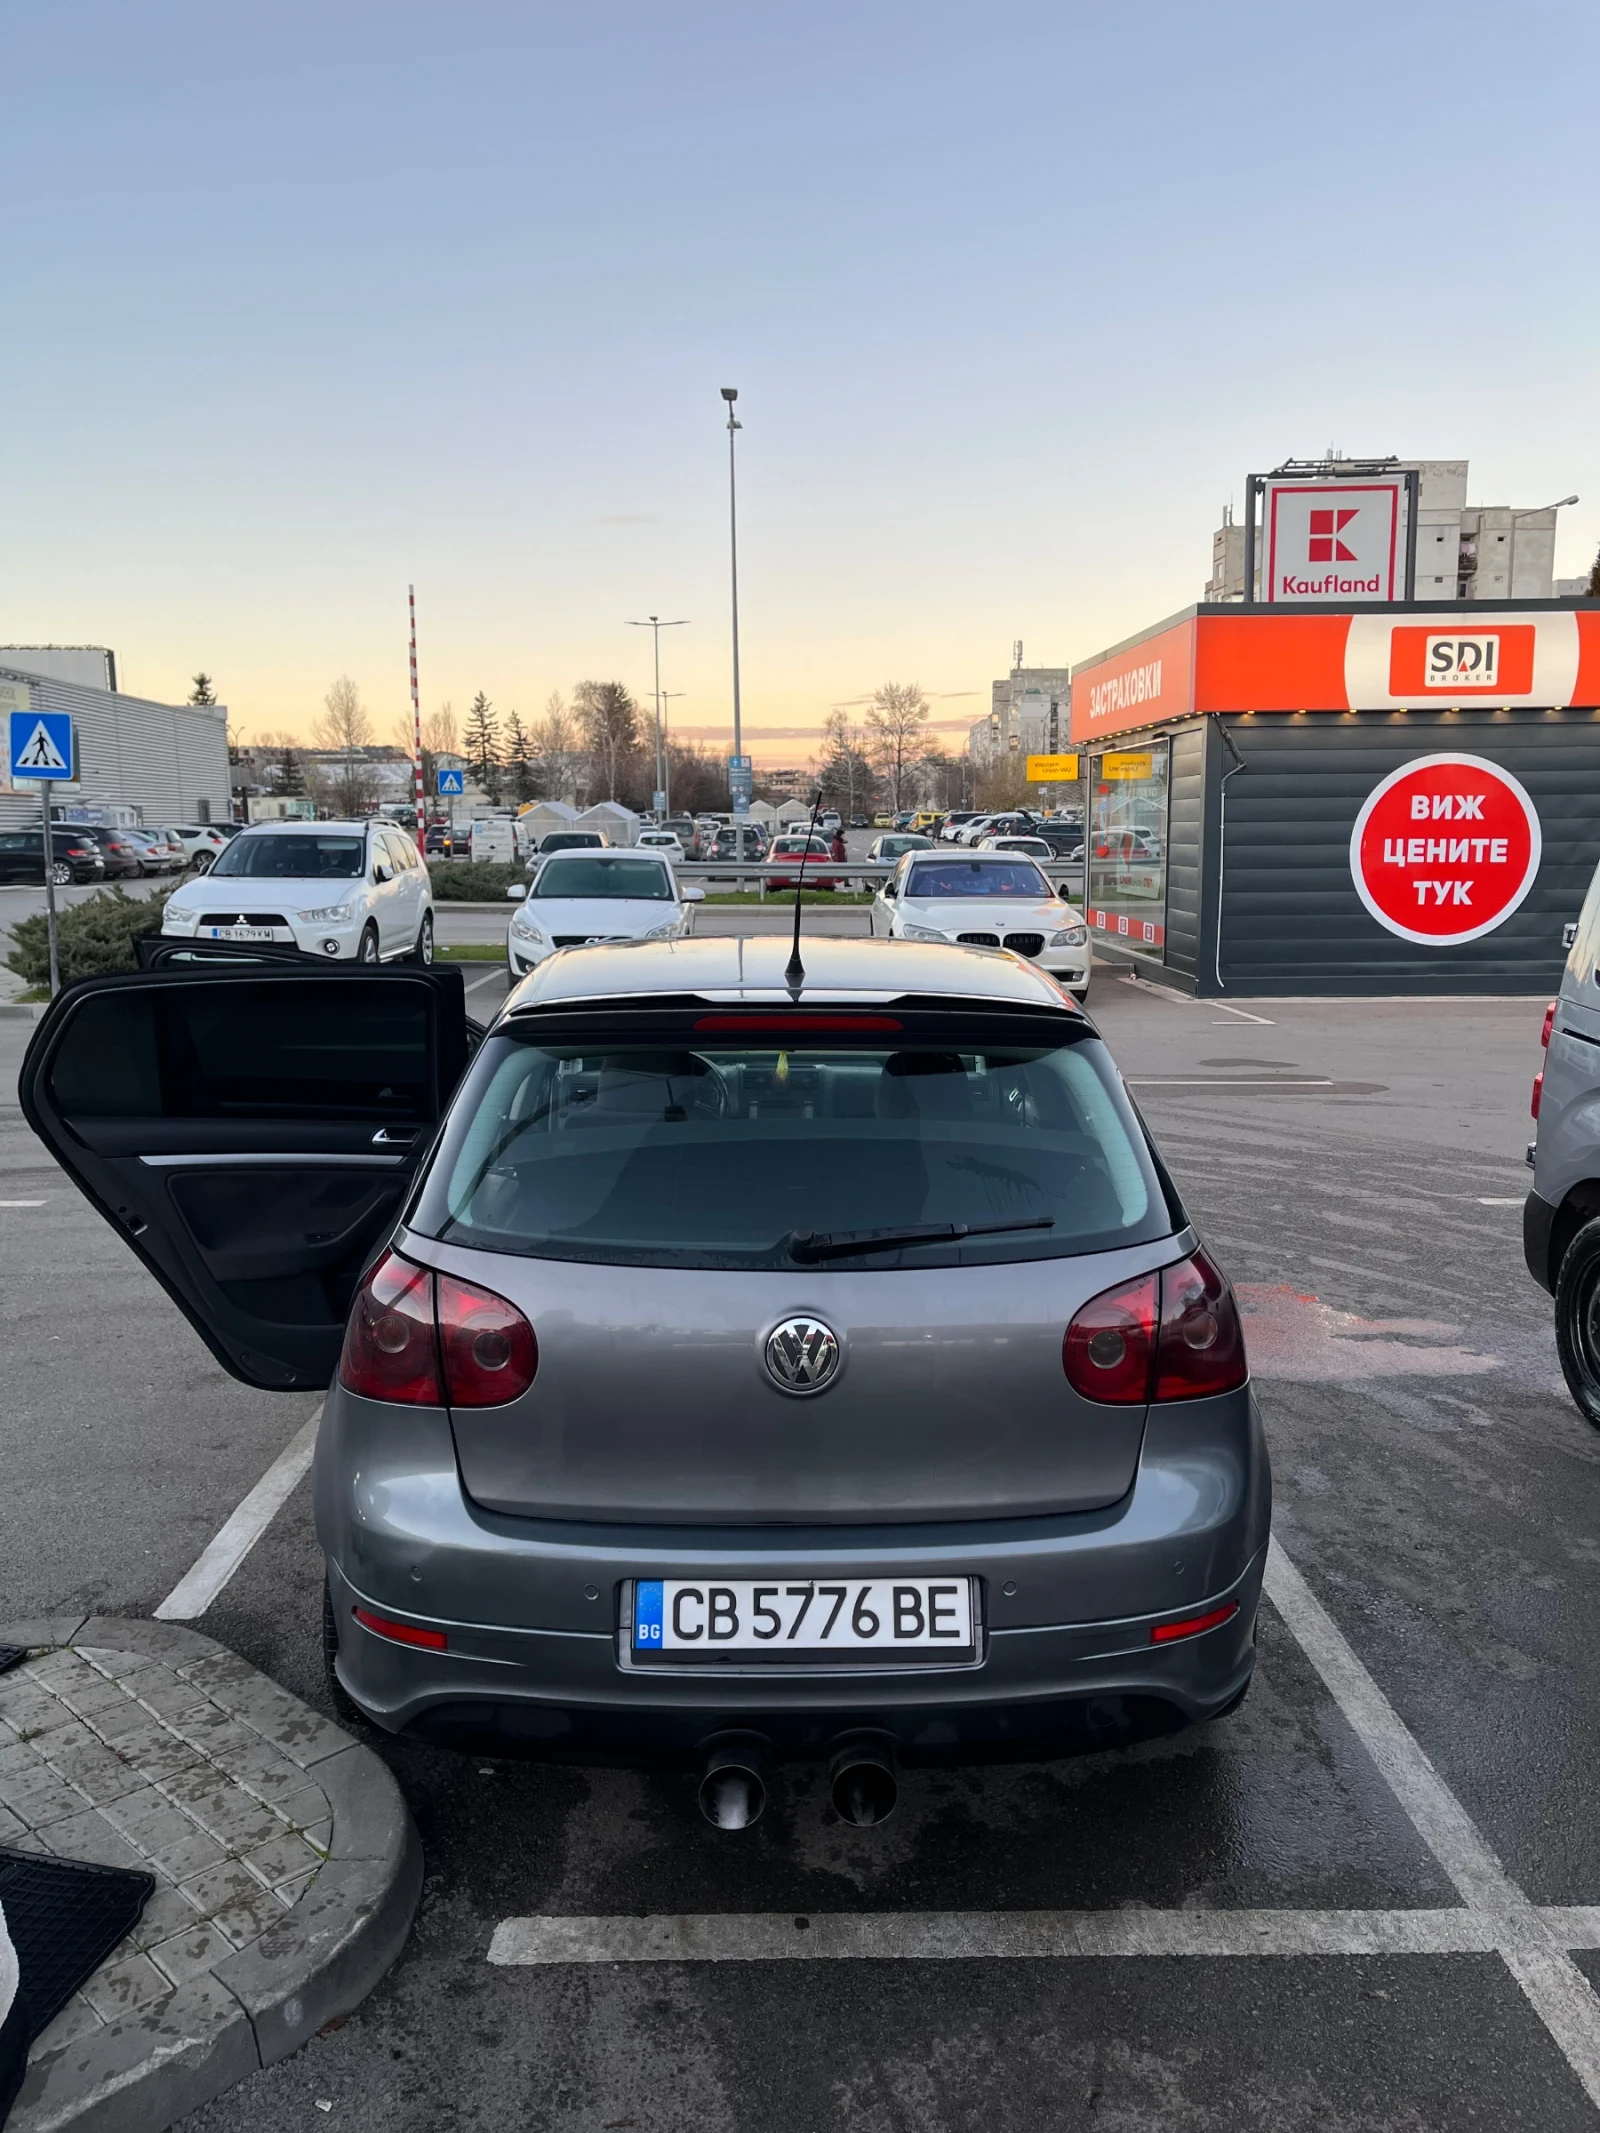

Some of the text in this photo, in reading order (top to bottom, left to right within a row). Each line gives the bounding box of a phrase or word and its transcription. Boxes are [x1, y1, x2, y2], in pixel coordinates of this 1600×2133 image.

[1282, 573, 1380, 595] Kaufland
[1431, 641, 1494, 673] SDI
[1089, 659, 1162, 719] ЗАСТРАХОВКИ
[1430, 674, 1492, 682] BROKER
[1410, 795, 1486, 820] ВИЖ
[1383, 838, 1509, 868] ЦЕНИТЕ
[1413, 881, 1474, 905] ТУК
[673, 1586, 960, 1641] CB 5776 BE
[638, 1624, 660, 1640] BG
